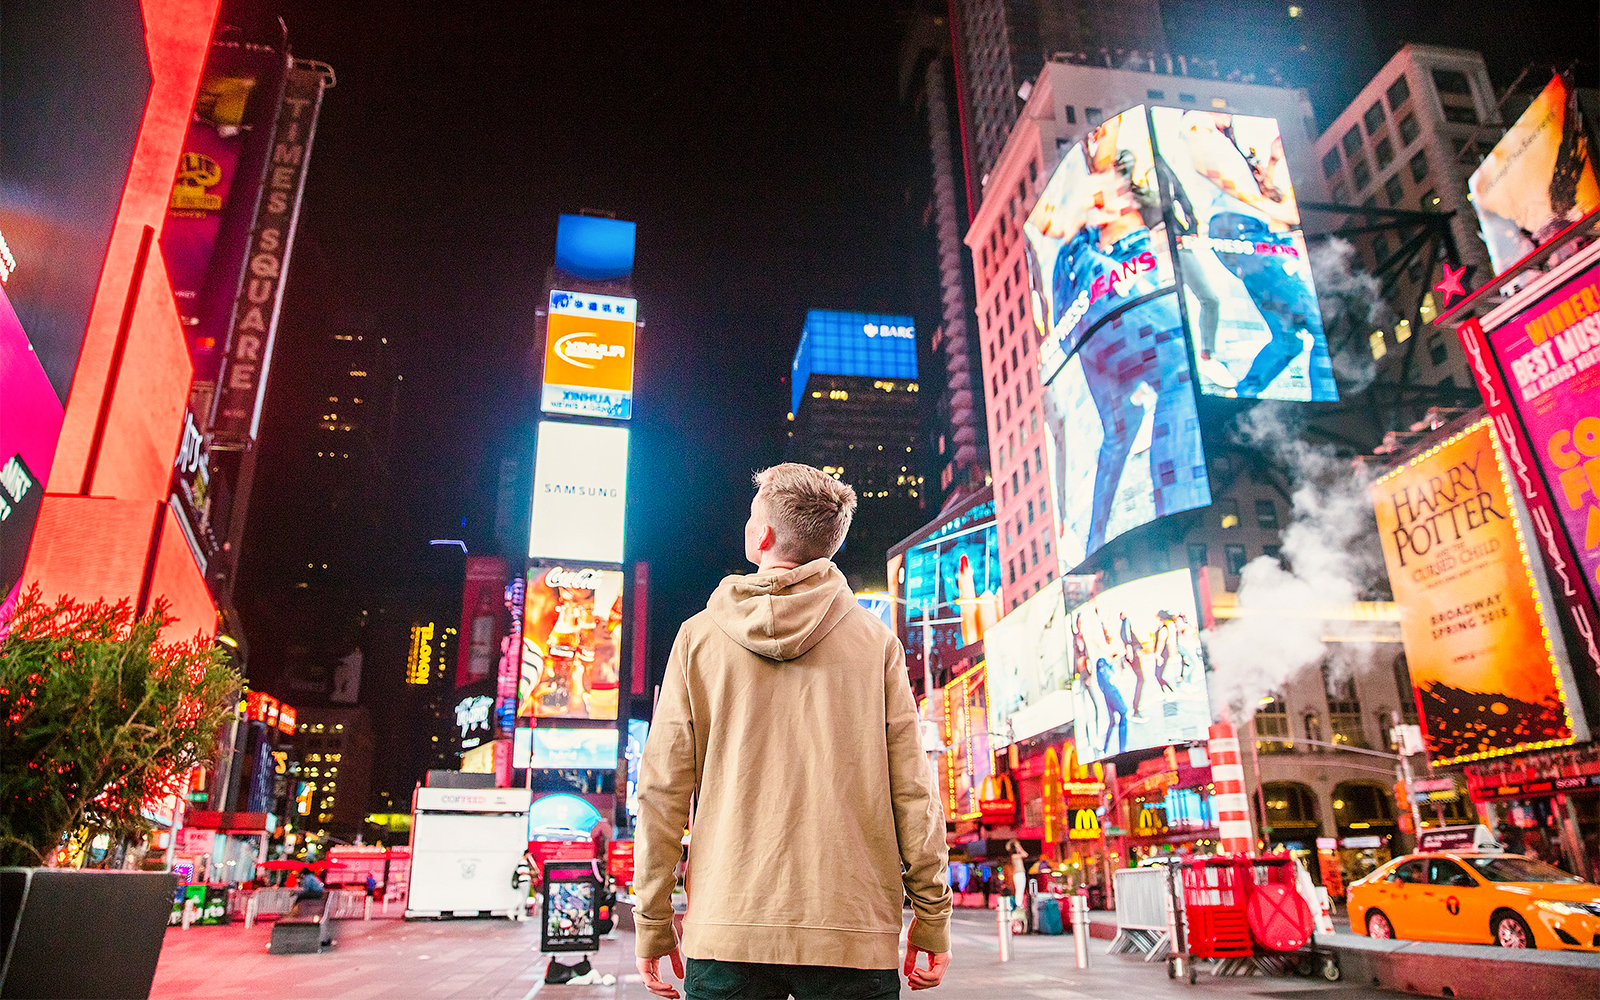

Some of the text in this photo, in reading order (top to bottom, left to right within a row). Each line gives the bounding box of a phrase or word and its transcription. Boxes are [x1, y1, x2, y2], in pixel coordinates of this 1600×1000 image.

[266, 97, 310, 214] TIMES
[1089, 251, 1156, 305] JEANS
[229, 227, 281, 391] SQUARE
[880, 324, 915, 339] BARC
[1524, 283, 1600, 346] WINNER!
[1510, 340, 1558, 388] BEST
[1554, 311, 1600, 363] MUS
[1538, 361, 1577, 392] ACROSS
[563, 391, 612, 406] XINHUA
[544, 483, 618, 498] SAMSUNG
[1391, 451, 1481, 529] HARRY
[1393, 491, 1506, 568] POTTER
[1430, 592, 1502, 627] BROADWAY
[1431, 615, 1477, 640] SPRING
[416, 622, 434, 685] NOVOTEL
[1555, 777, 1587, 790] SONY
